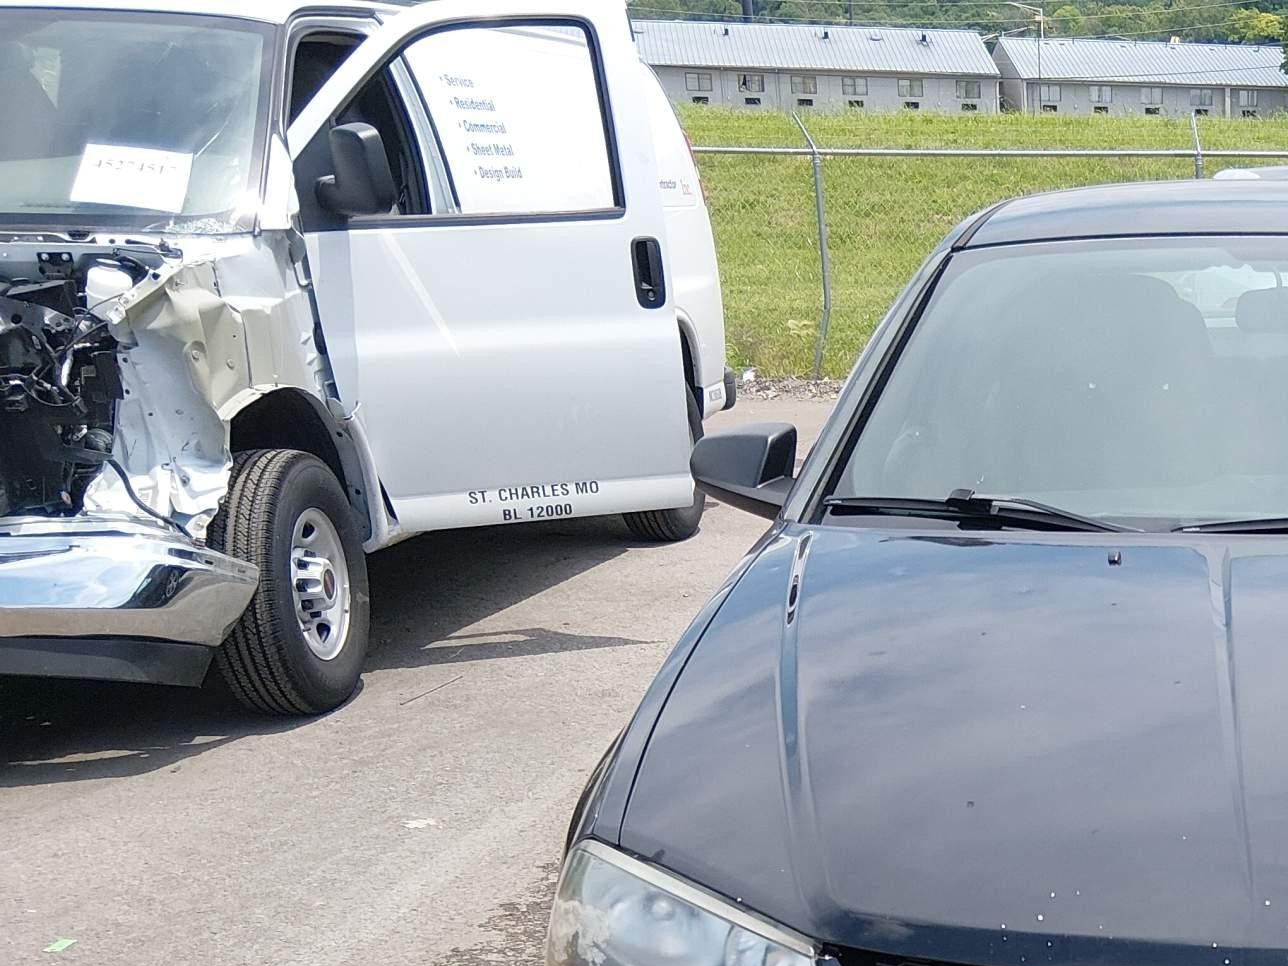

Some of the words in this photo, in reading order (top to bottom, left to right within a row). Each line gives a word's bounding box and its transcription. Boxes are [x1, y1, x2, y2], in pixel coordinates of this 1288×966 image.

[443, 73, 474, 88] Service
[453, 97, 496, 112] Residential
[463, 119, 507, 134] Commercial
[471, 142, 492, 156] Sheet
[493, 143, 514, 157] Metal
[478, 166, 503, 182] Design
[504, 166, 523, 179] Build
[468, 490, 492, 505] ST.
[498, 482, 570, 502] CHARLES
[575, 480, 600, 495] MO
[502, 508, 522, 521] BL
[527, 503, 573, 519] 12000
